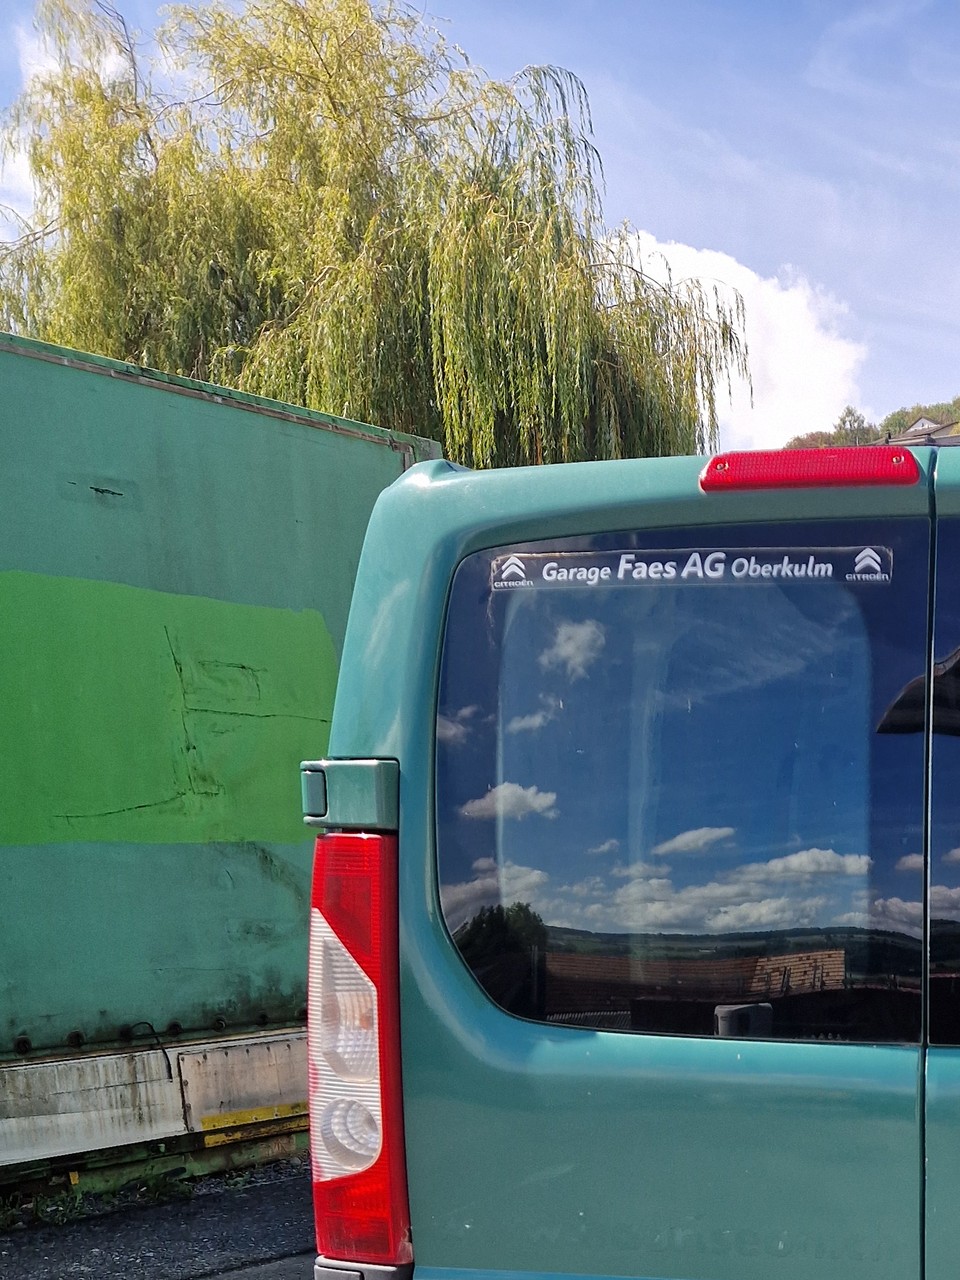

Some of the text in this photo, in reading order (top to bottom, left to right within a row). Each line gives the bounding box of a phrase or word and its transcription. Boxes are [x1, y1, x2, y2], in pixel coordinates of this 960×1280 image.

[542, 552, 834, 585] Garage Faes AG Oberkulm
